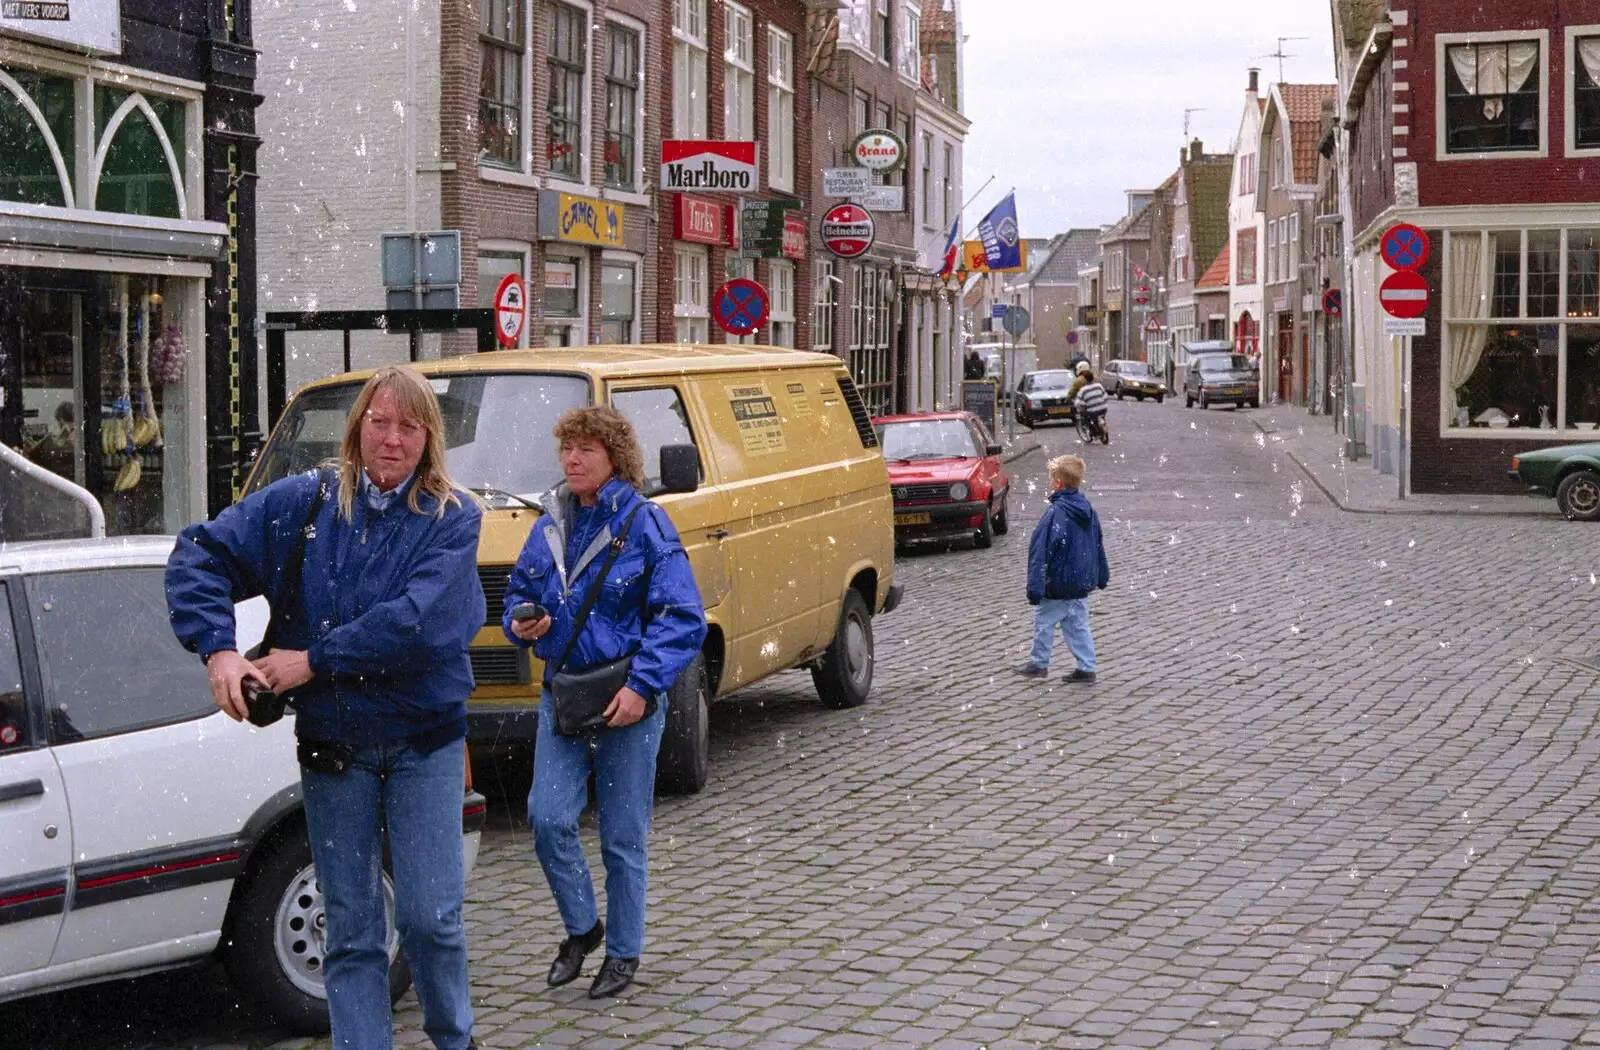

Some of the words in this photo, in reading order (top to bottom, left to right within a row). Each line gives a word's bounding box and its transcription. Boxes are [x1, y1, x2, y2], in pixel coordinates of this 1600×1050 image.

[3, 3, 20, 17] MET
[22, 4, 40, 18] VERS
[41, 5, 69, 19] VOOROP
[858, 143, 898, 157] Brand
[667, 161, 750, 189] Marlboro
[562, 201, 600, 239] CAMEL
[688, 201, 714, 233] Turks
[825, 225, 870, 236] Heineken
